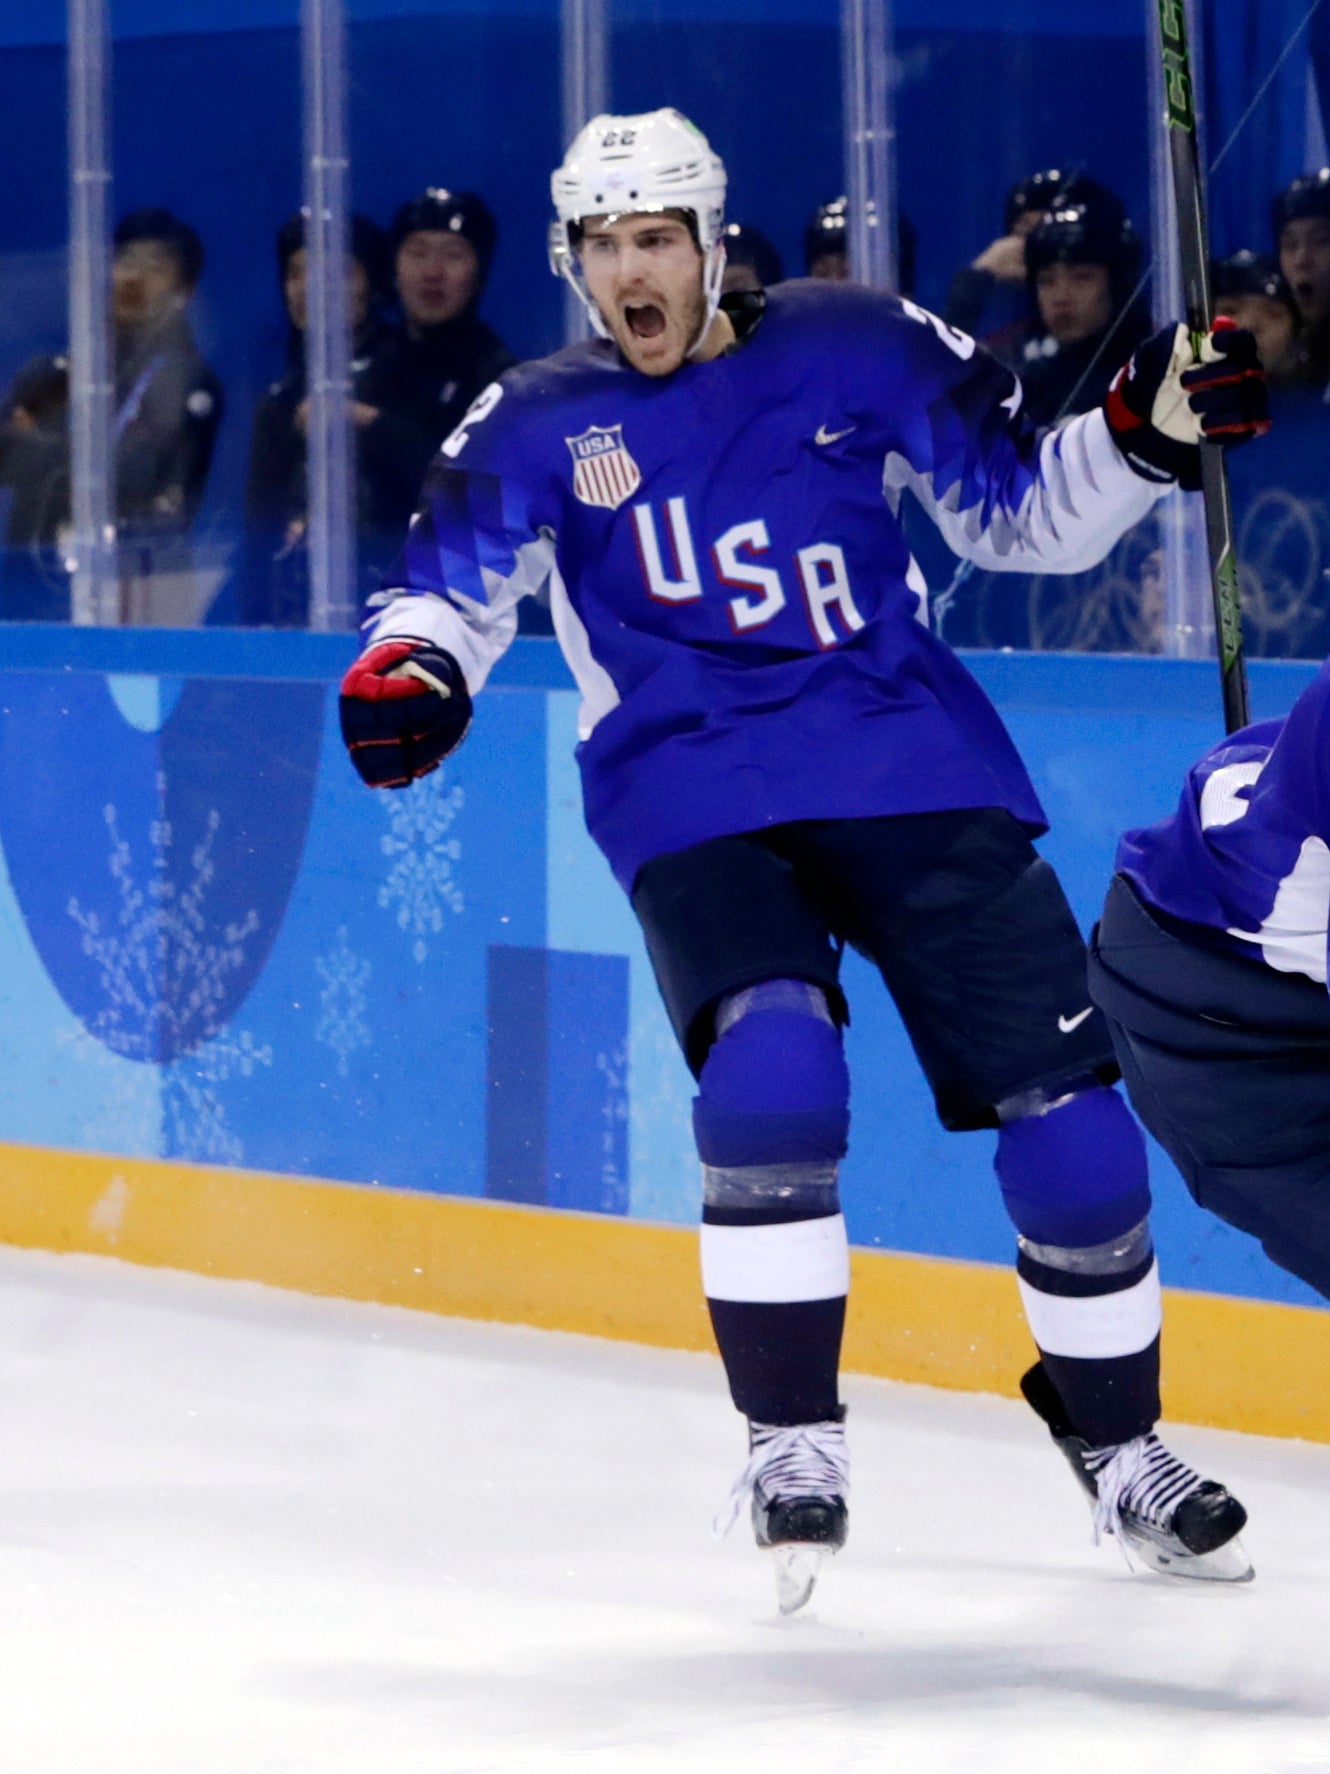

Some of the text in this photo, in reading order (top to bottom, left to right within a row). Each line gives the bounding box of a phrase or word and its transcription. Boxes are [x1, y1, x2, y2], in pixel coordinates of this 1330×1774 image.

[602, 130, 636, 147] 22
[577, 434, 616, 456] USA
[630, 496, 866, 651] USA
